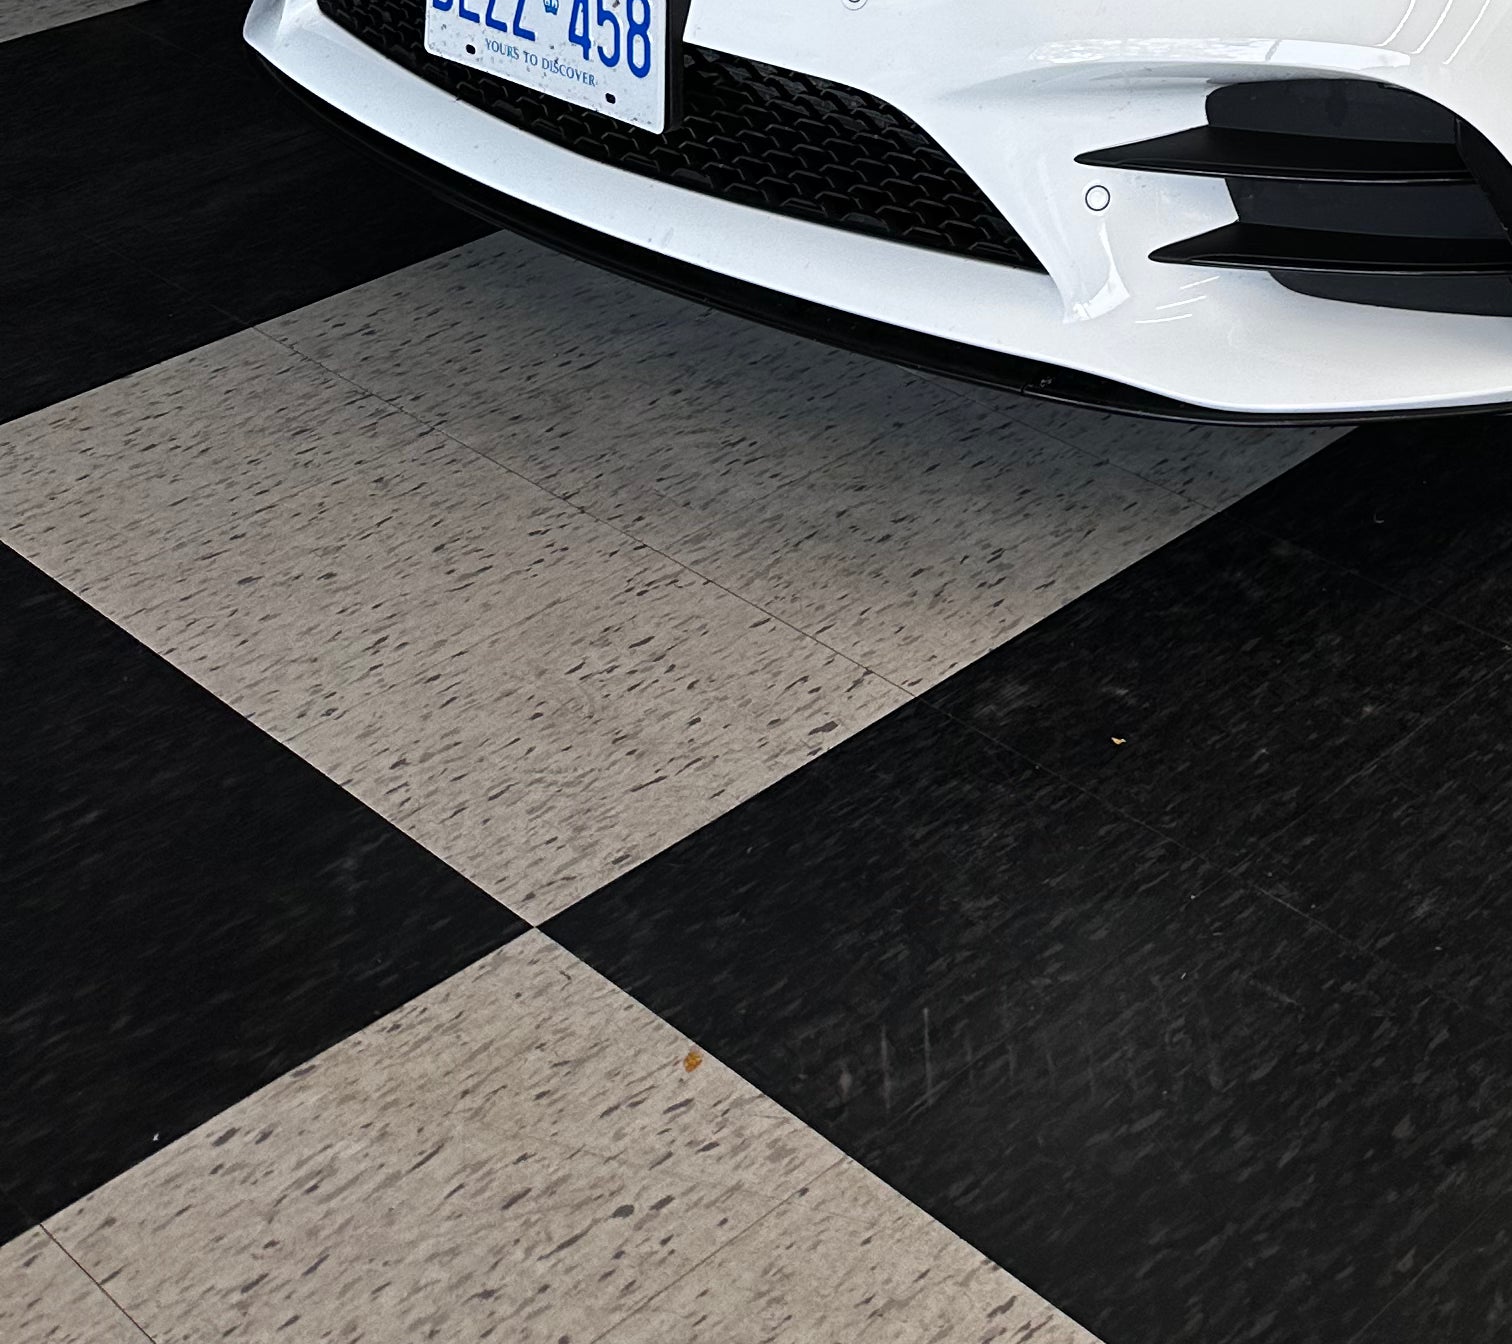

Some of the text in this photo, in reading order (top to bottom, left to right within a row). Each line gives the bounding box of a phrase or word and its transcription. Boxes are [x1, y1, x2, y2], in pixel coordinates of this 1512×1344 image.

[485, 37, 597, 88] YOURS TO DISCOVER
